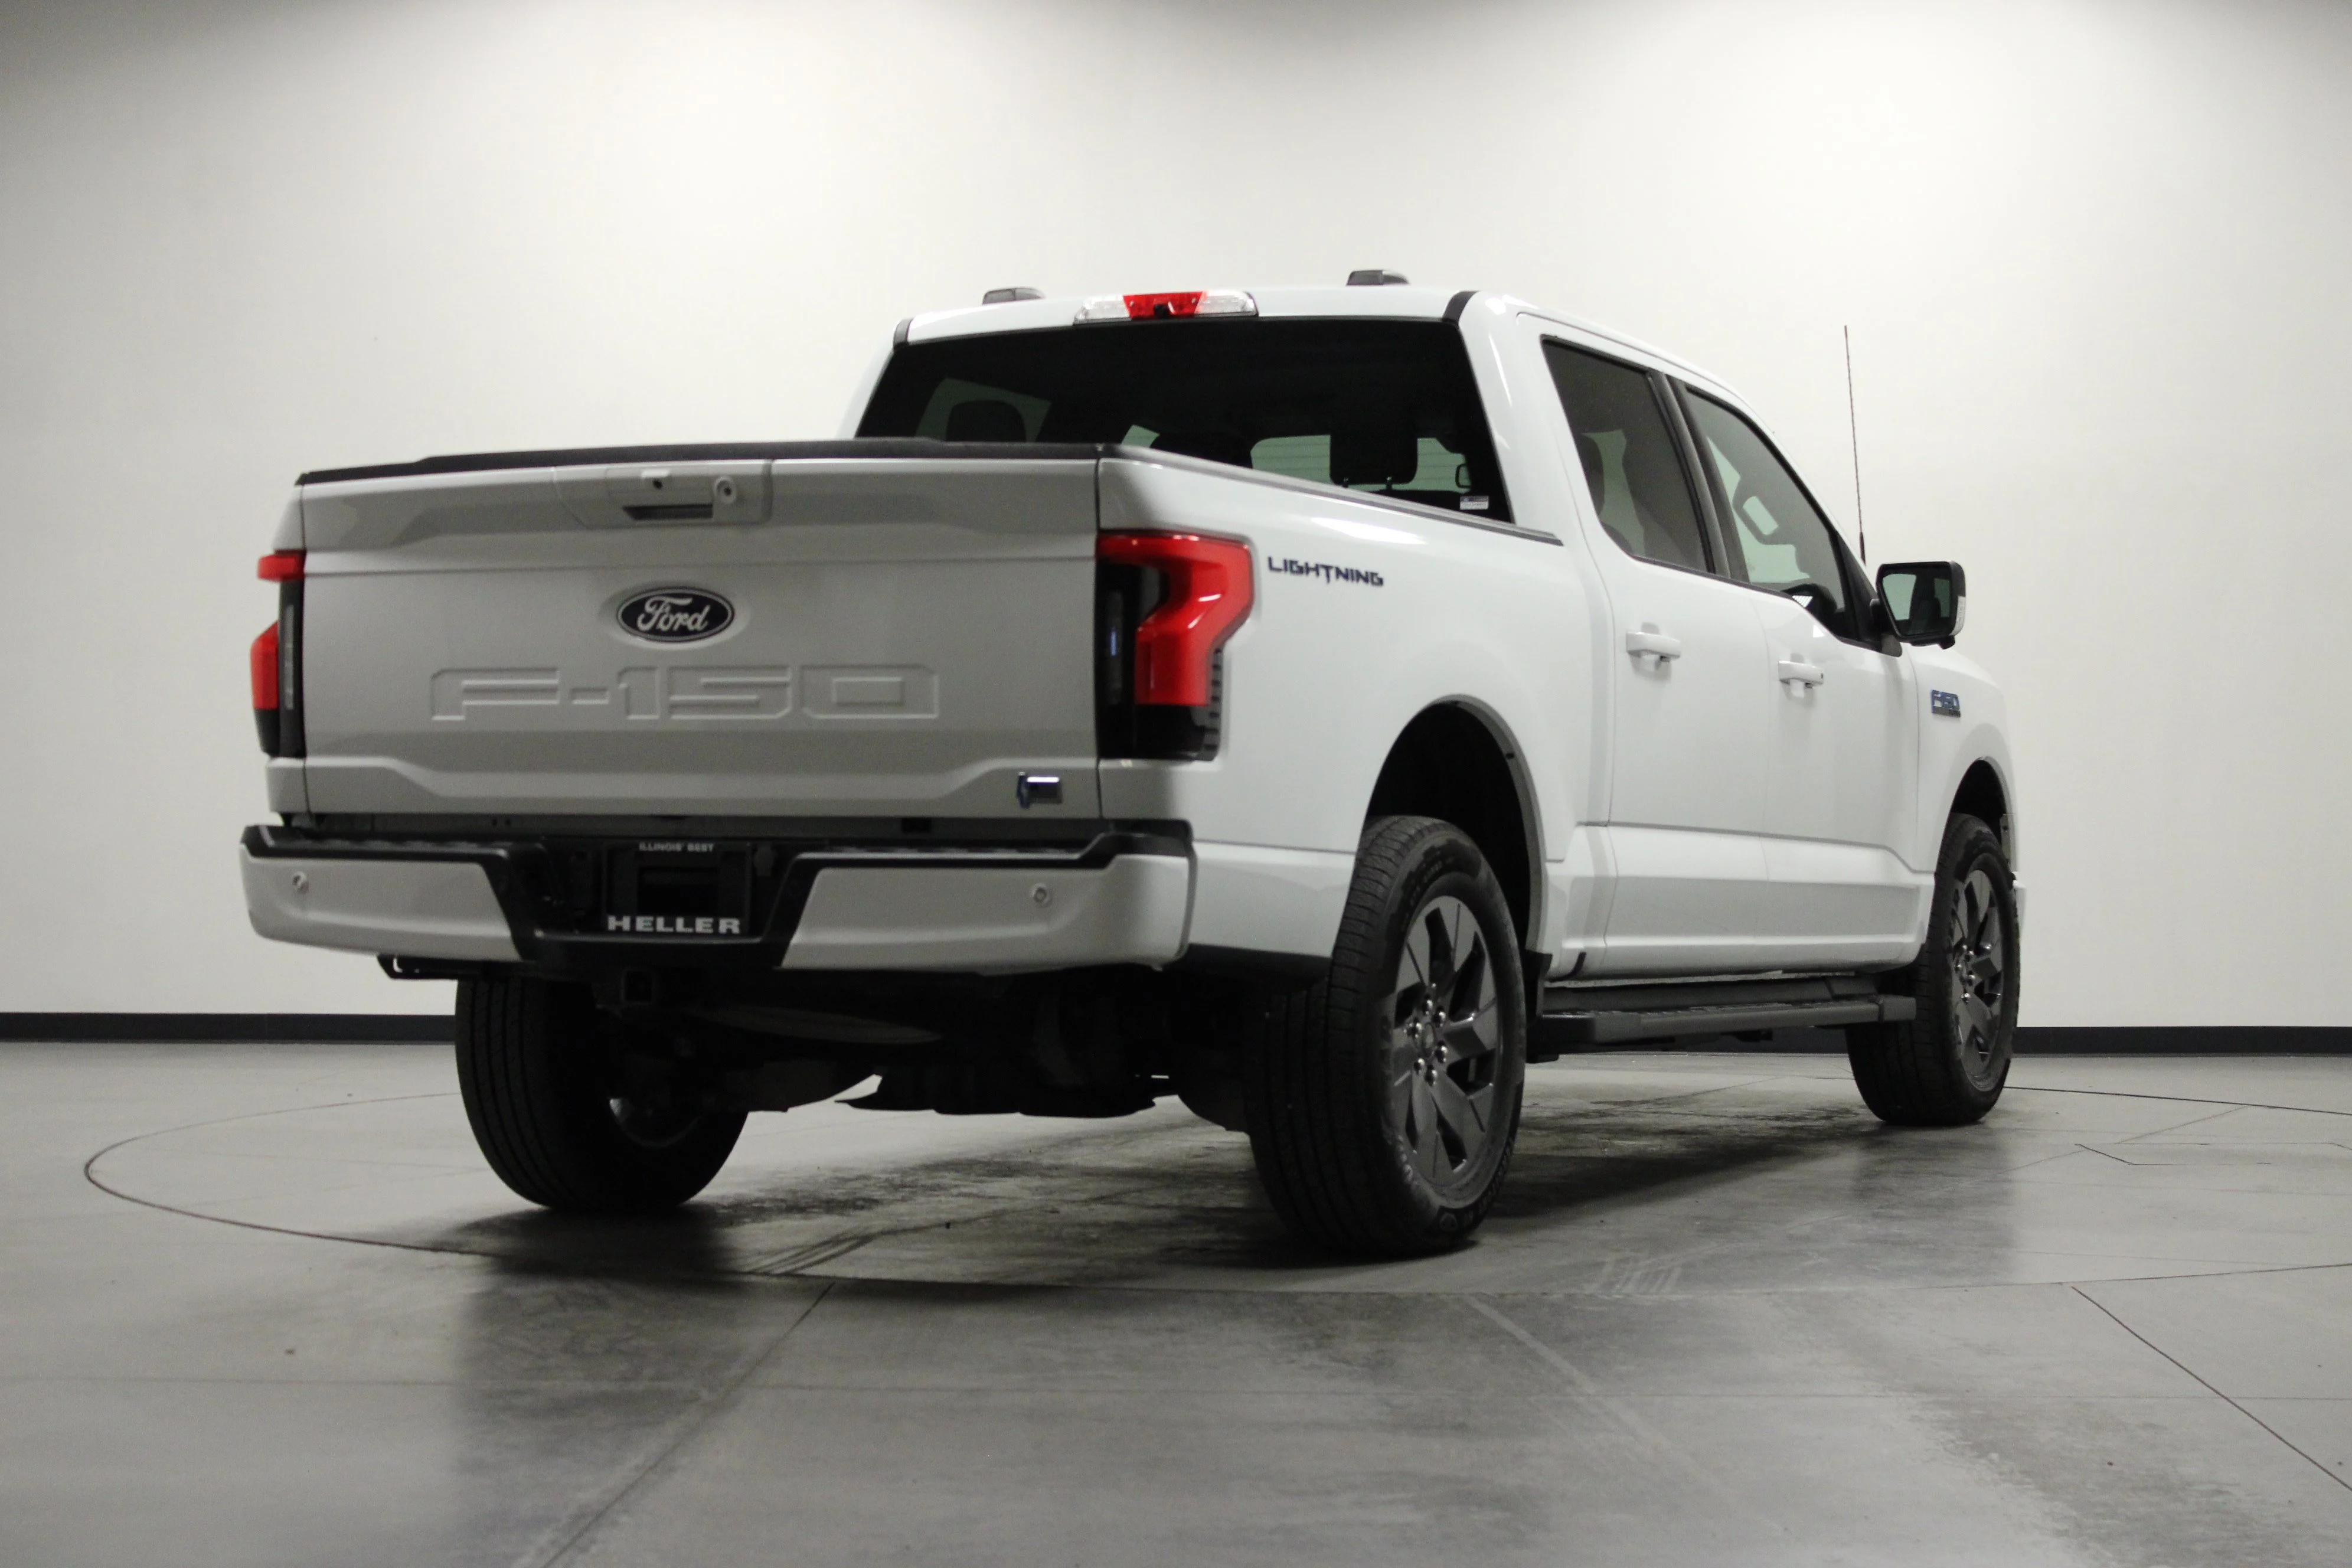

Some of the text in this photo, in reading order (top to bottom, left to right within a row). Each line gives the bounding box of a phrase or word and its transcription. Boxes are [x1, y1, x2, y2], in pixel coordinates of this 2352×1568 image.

[1268, 557, 1384, 586] LIGHTNING
[637, 595, 710, 632] Ford
[430, 664, 940, 721] F-150
[687, 842, 715, 852] BEST
[607, 916, 740, 934] HELLER
